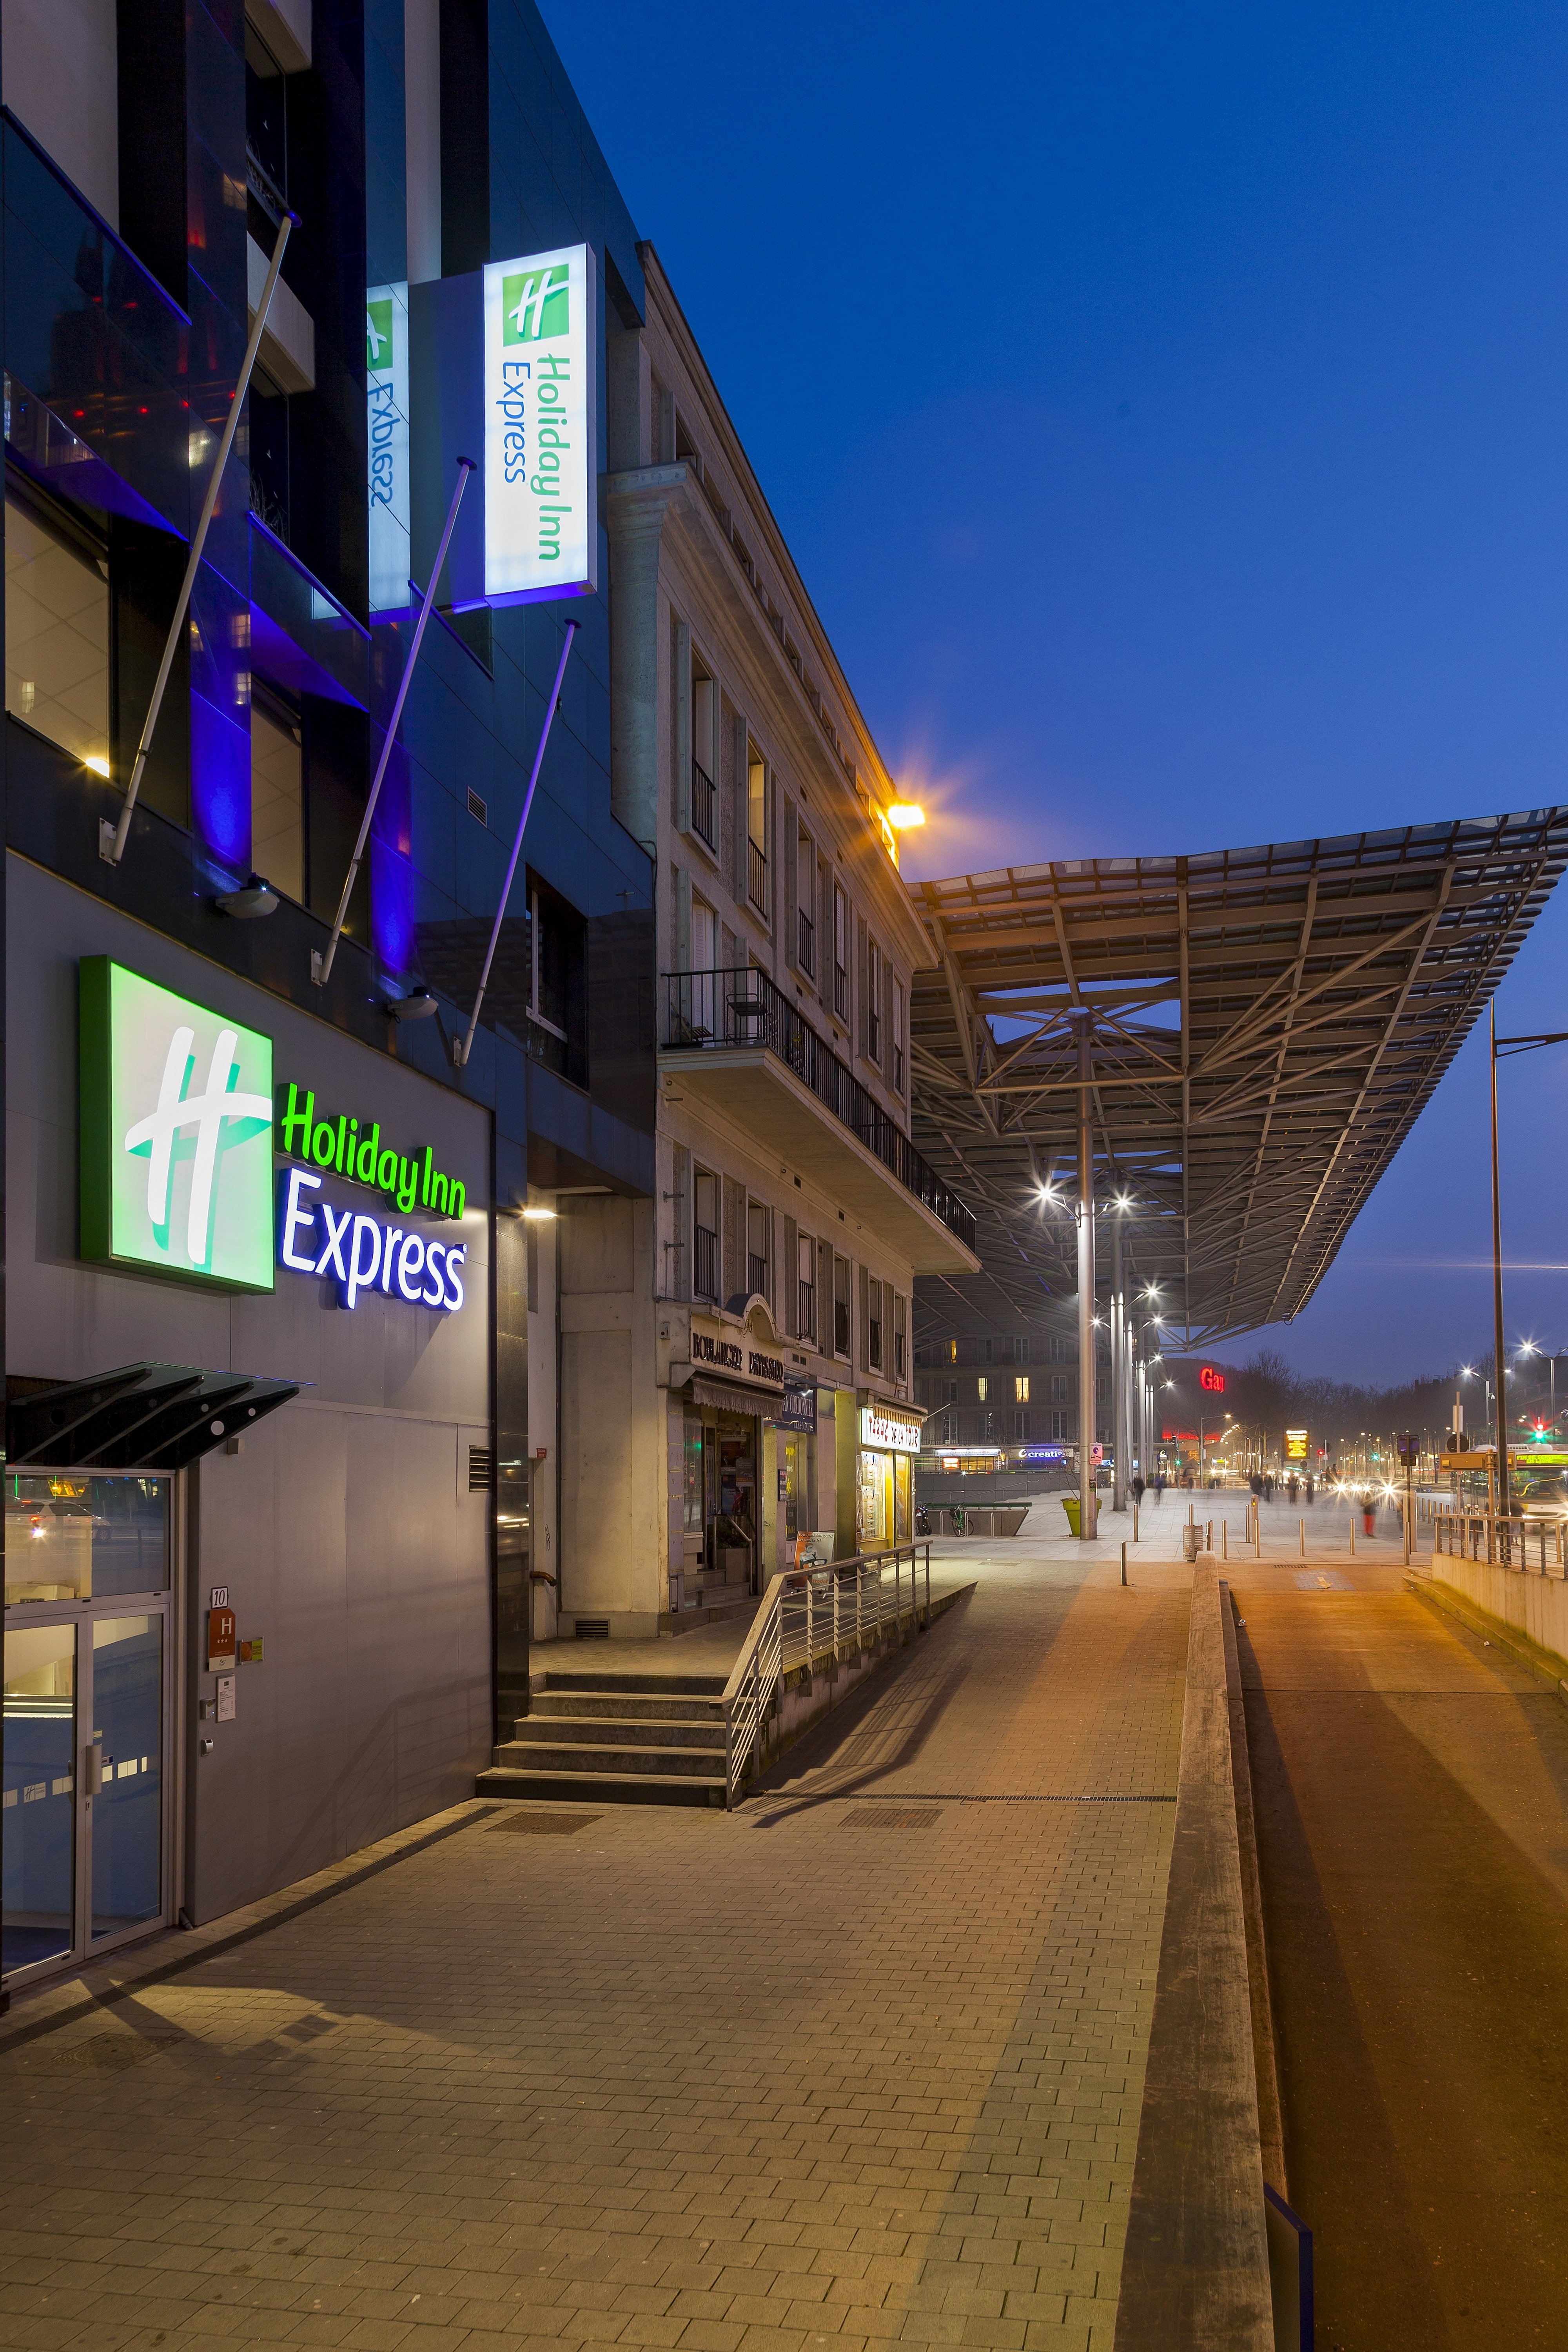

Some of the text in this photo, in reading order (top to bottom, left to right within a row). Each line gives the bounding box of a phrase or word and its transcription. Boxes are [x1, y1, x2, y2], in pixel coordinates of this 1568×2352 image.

[496, 362, 530, 483] Express
[530, 353, 572, 560] Holiday Inn
[281, 1082, 465, 1219] Holiday Inn
[283, 1168, 465, 1311] Express
[692, 1332, 743, 1371] BOULANGER
[790, 1394, 813, 1417] CORDONNIER
[869, 1416, 918, 1447] TABAC DE LA TOUR
[214, 1590, 225, 1606] 10
[221, 1617, 233, 1635] H
